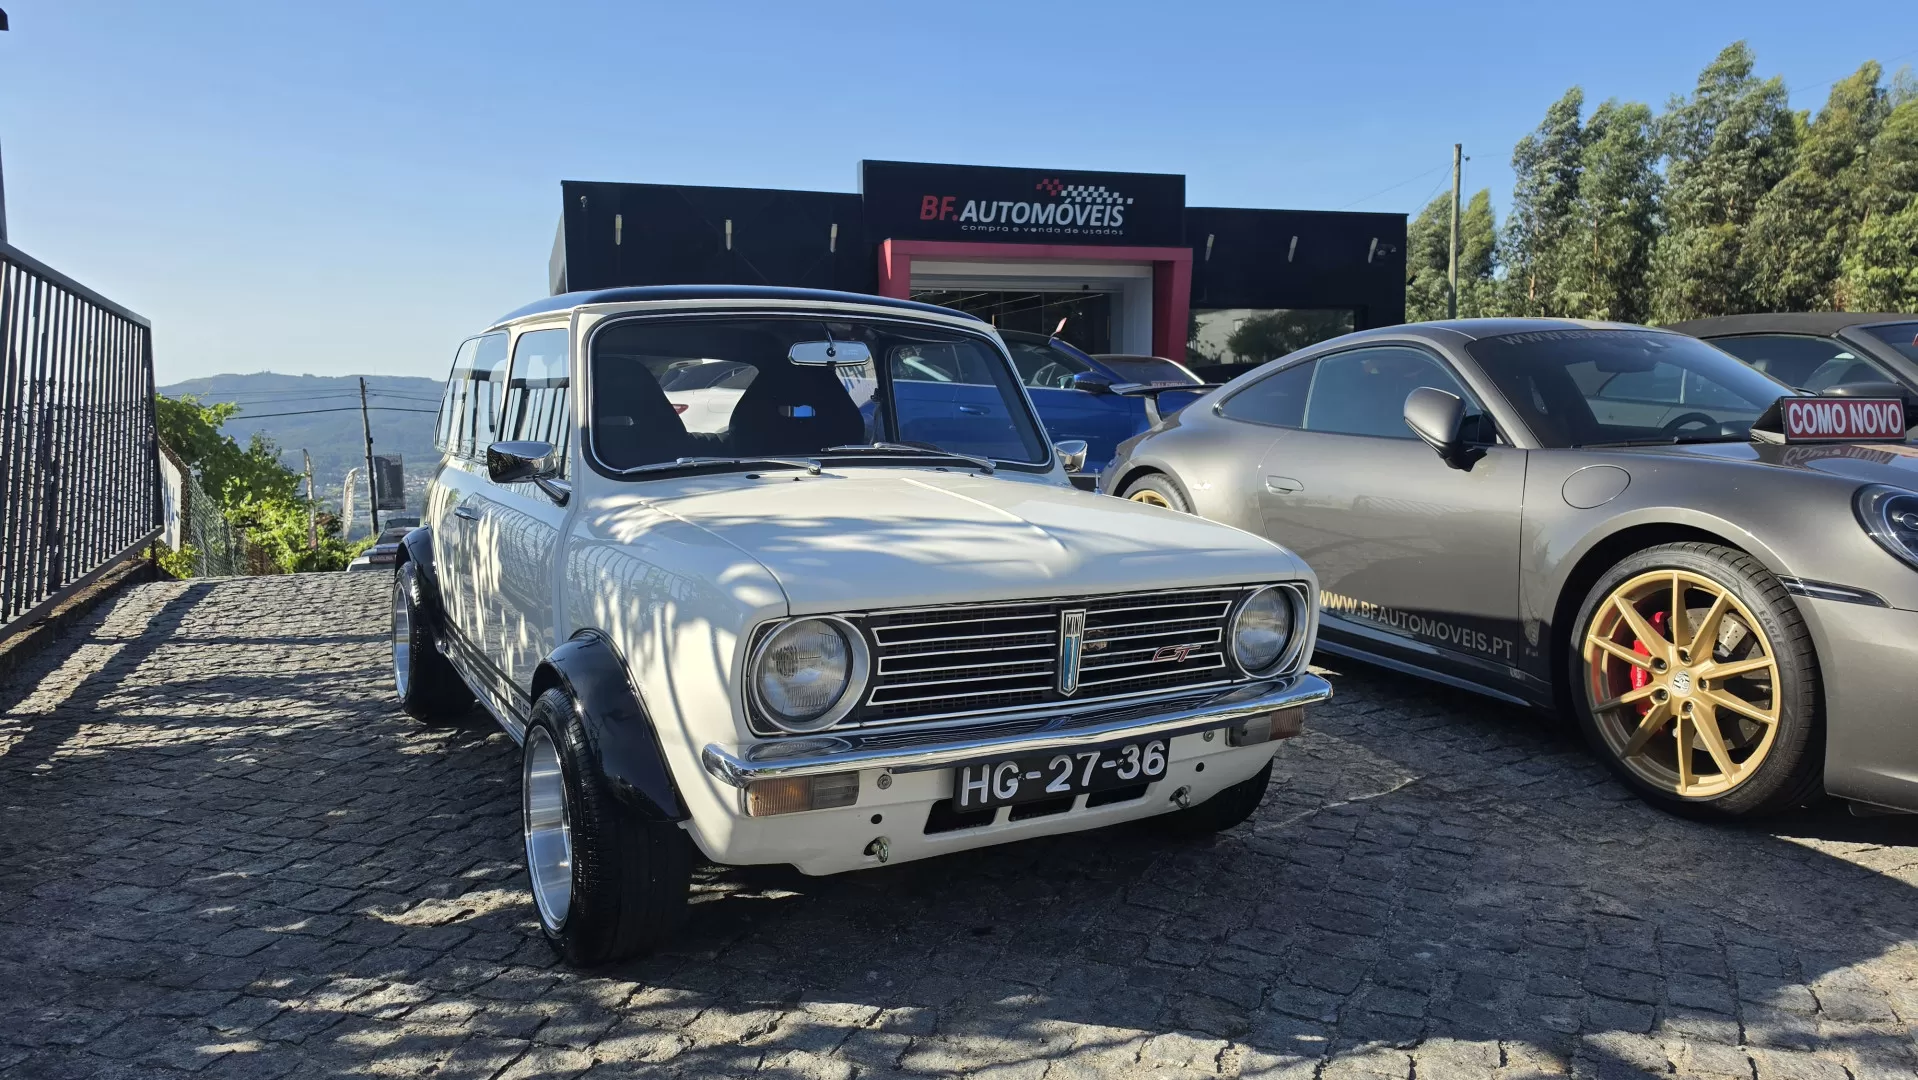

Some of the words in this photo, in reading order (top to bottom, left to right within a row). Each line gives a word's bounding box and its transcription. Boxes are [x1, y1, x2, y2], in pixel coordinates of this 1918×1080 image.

[961, 225, 1009, 233] compra
[1064, 227, 1079, 235] de
[1082, 228, 1124, 236] usados
[1788, 403, 1847, 434] COMO
[1849, 403, 1901, 434] NOVO
[1152, 644, 1201, 662] GT
[960, 740, 1166, 807] HG-27-36
